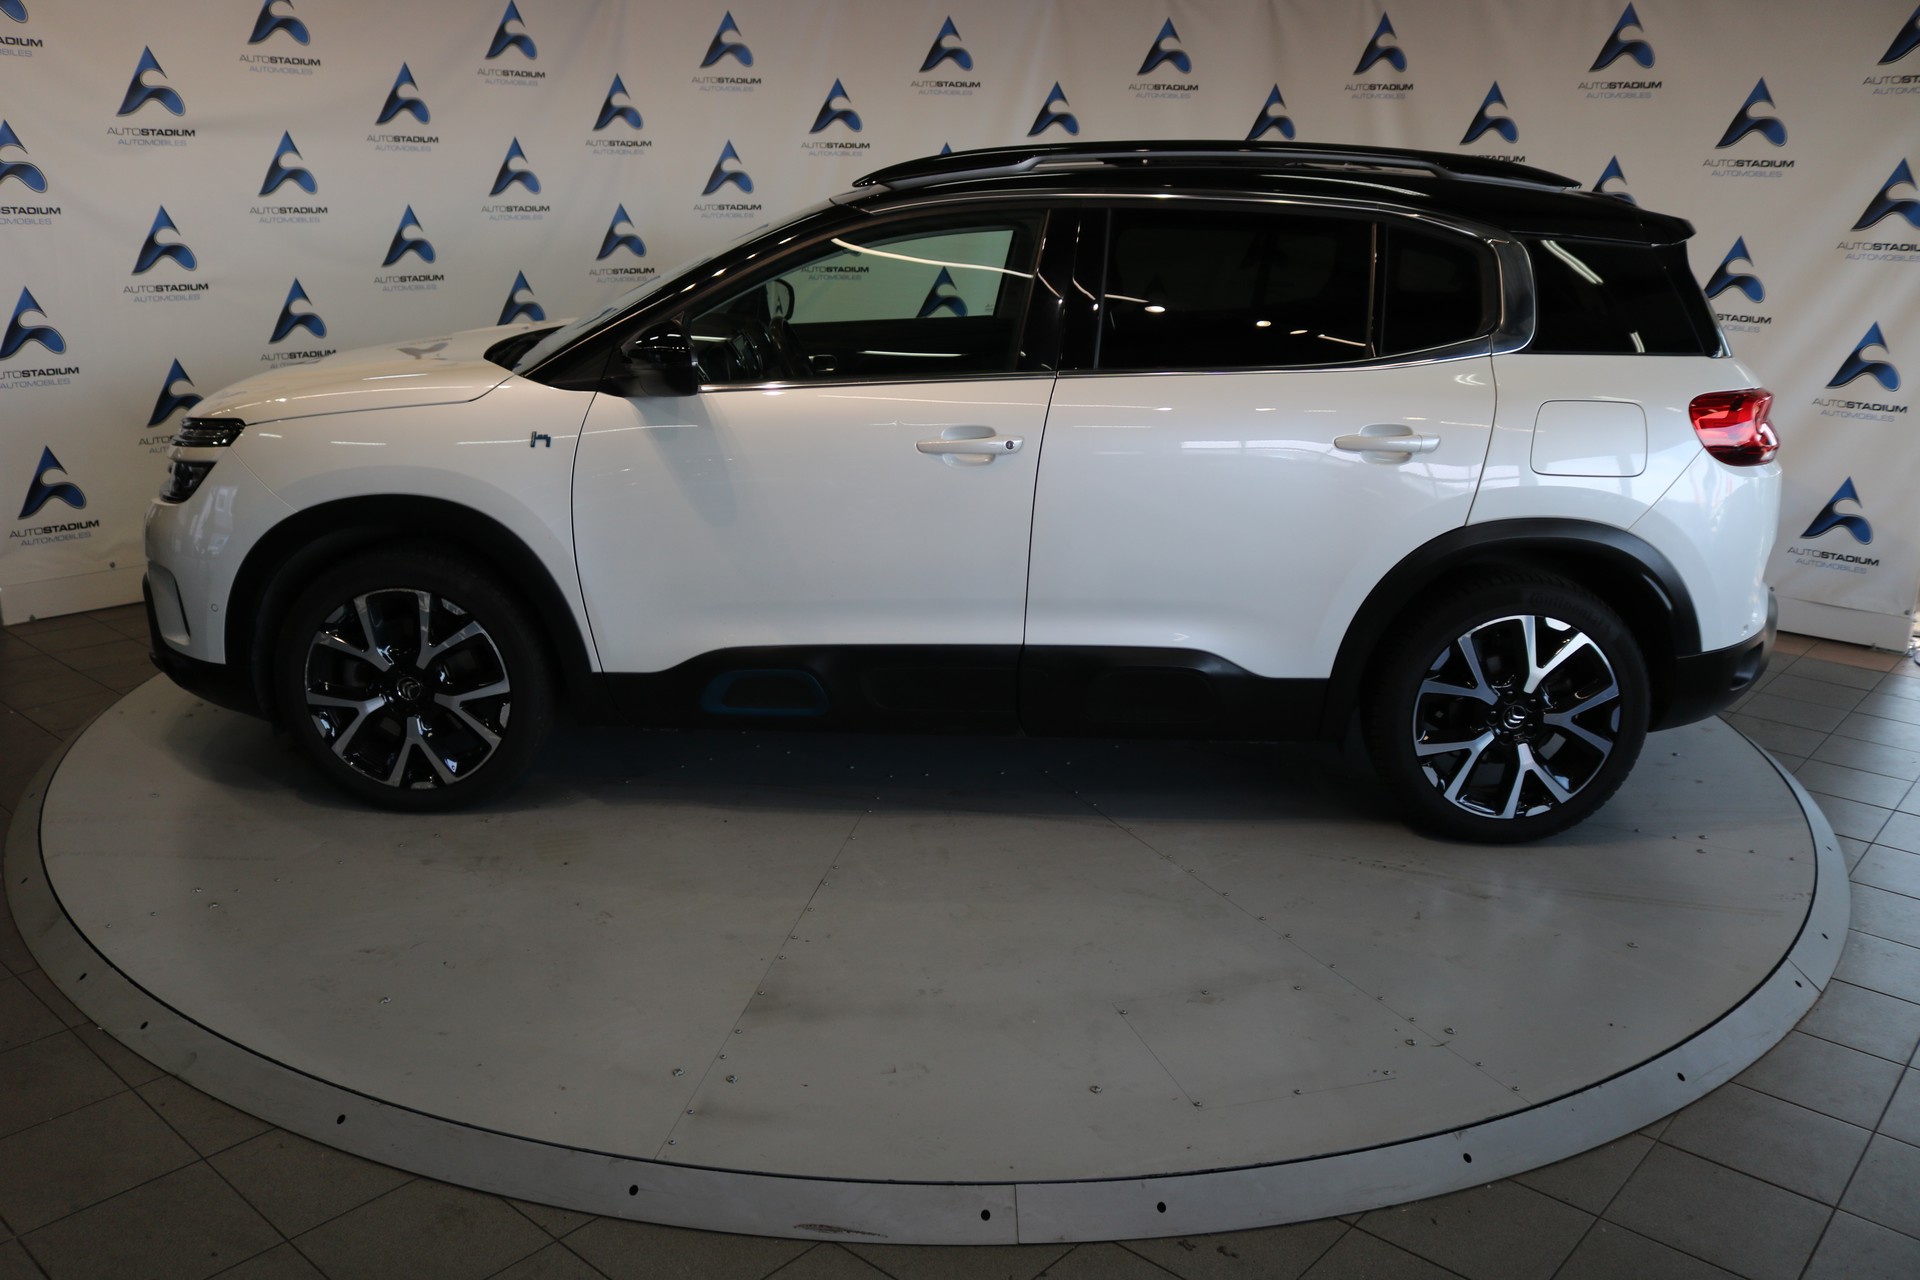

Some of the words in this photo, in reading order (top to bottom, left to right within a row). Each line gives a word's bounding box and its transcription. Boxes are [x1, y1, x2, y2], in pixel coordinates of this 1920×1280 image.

[239, 54, 321, 66] AUTOSTADIUM
[249, 66, 312, 74] AUTOMOBILES
[477, 68, 545, 78] AUTOSTADIUM
[485, 78, 538, 86] AUTOMOBILES
[1578, 81, 1662, 89] AUTOSTADIUM
[1863, 76, 1920, 85] AUTOST
[1128, 83, 1198, 91] AUTOSTADIUM
[1344, 83, 1413, 91] AUTOSTADIUM
[107, 128, 195, 137] AUTOSTADIUM
[118, 138, 187, 146] AUTOMOBILES
[367, 134, 439, 143] AUTOSTADIUM
[585, 139, 652, 147] AUTOSTADIUM
[1703, 159, 1794, 168] AUTOSTADIUM
[1711, 170, 1782, 178] AUTOMOBILES
[0, 206, 61, 215] STADIUM
[589, 267, 655, 276] AUTOSTADIUM
[374, 275, 444, 284] AUTOSTADIUM
[123, 283, 208, 293] AUTOSTADIUM
[382, 284, 437, 292] AUTOMOBILES
[134, 294, 200, 302] AUTOMOBILES
[0, 379, 70, 389] AUTOMOBILES
[1812, 398, 1908, 413] AUTOSTADIUM
[1821, 409, 1894, 422] AUTOMOBILES
[138, 434, 174, 446] AUTO
[9, 520, 99, 538] AUTOSTADIUM
[21, 532, 91, 546] AUTOMOBILES
[1788, 547, 1879, 566] AUTOSTADIUM
[1796, 558, 1867, 574] AUTOMOBILES
